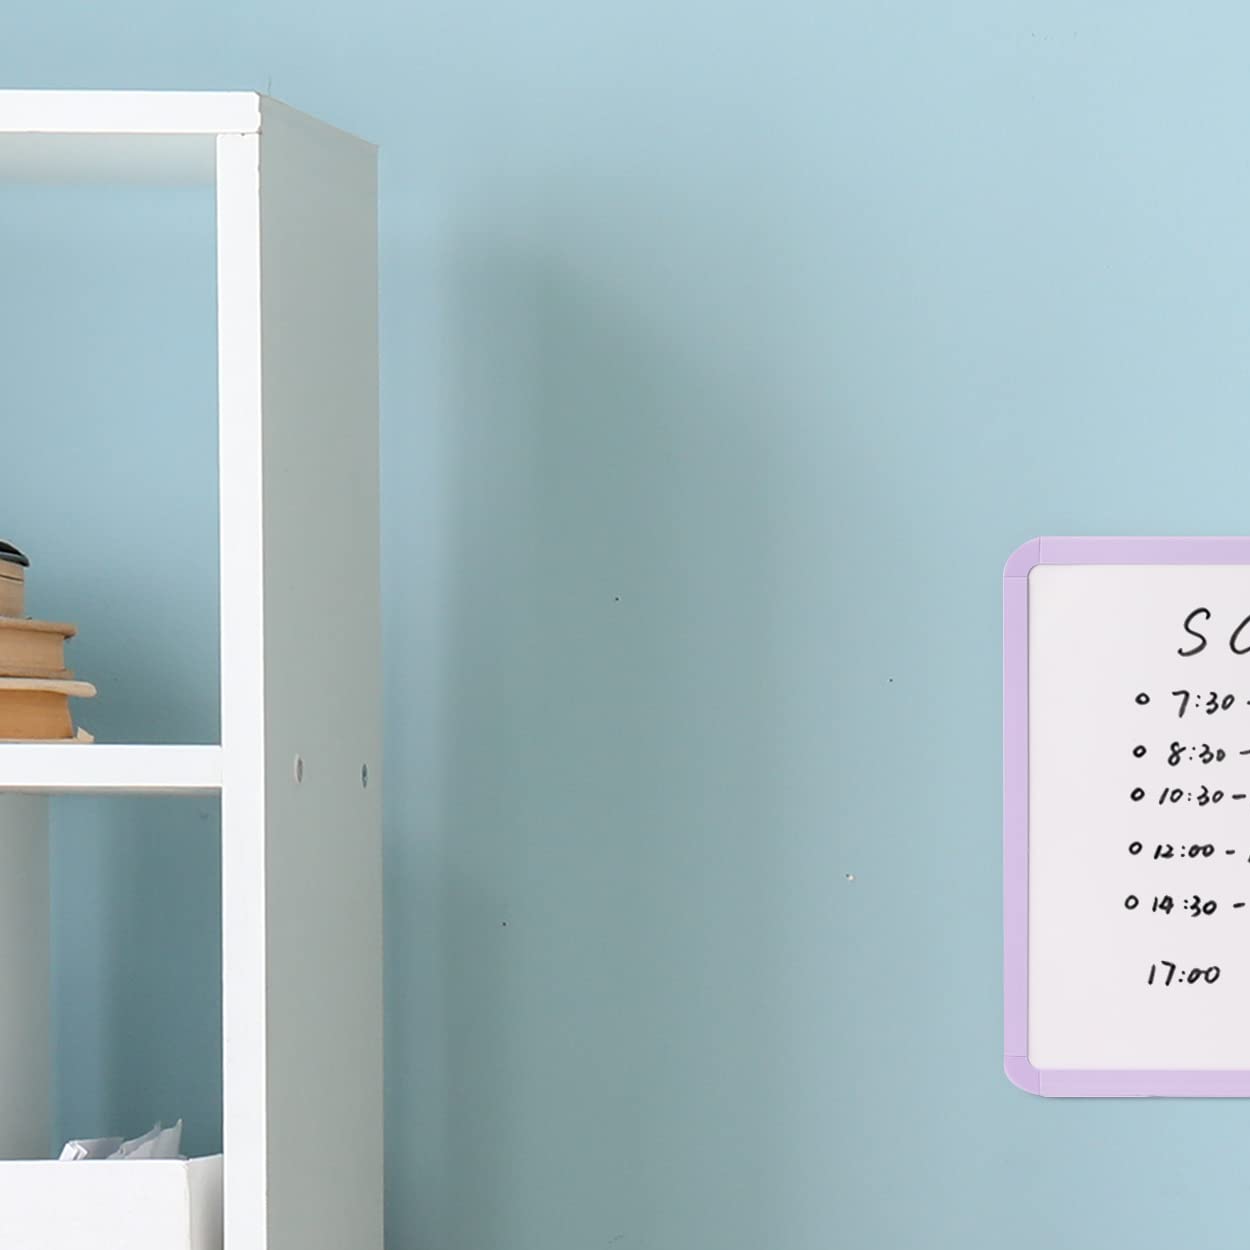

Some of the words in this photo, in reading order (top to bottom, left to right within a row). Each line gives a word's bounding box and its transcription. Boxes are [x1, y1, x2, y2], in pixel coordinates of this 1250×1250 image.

[1171, 689, 1236, 719] 7:30
[1167, 741, 1226, 767] 8:30
[1153, 843, 1216, 860] 12:00
[1151, 894, 1218, 918] 14:30
[1147, 960, 1221, 987] 17:00
